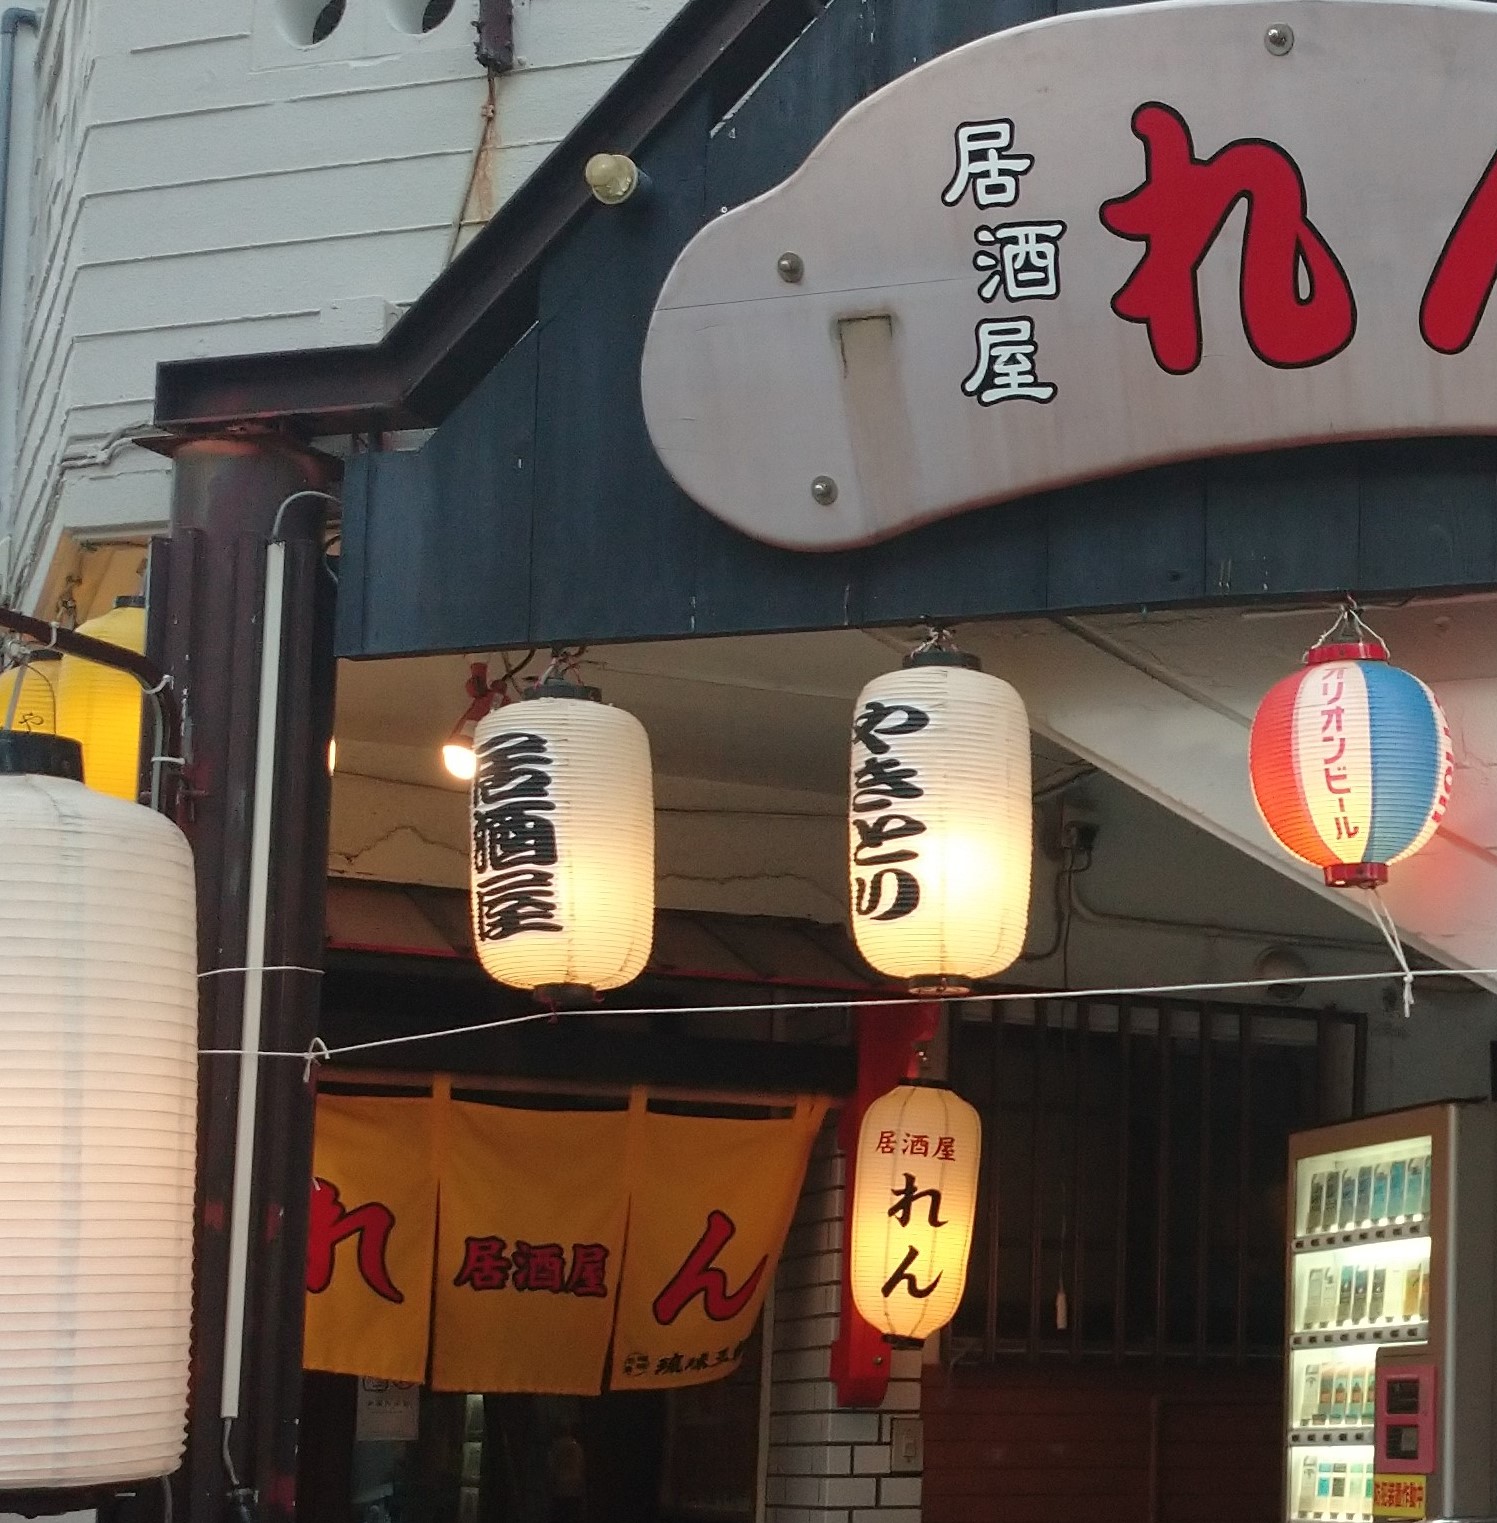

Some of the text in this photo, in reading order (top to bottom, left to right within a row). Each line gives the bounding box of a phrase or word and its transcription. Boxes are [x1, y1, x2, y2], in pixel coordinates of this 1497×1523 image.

[941, 118, 1066, 406] 居酒屋
[474, 731, 563, 942] 居酒屋
[852, 701, 930, 920] やきとり
[1322, 667, 1360, 841] オリオンビール
[877, 1130, 956, 1162] 居酒屋
[453, 1235, 610, 1298] 居酒屋
[881, 1173, 948, 1299] れん
